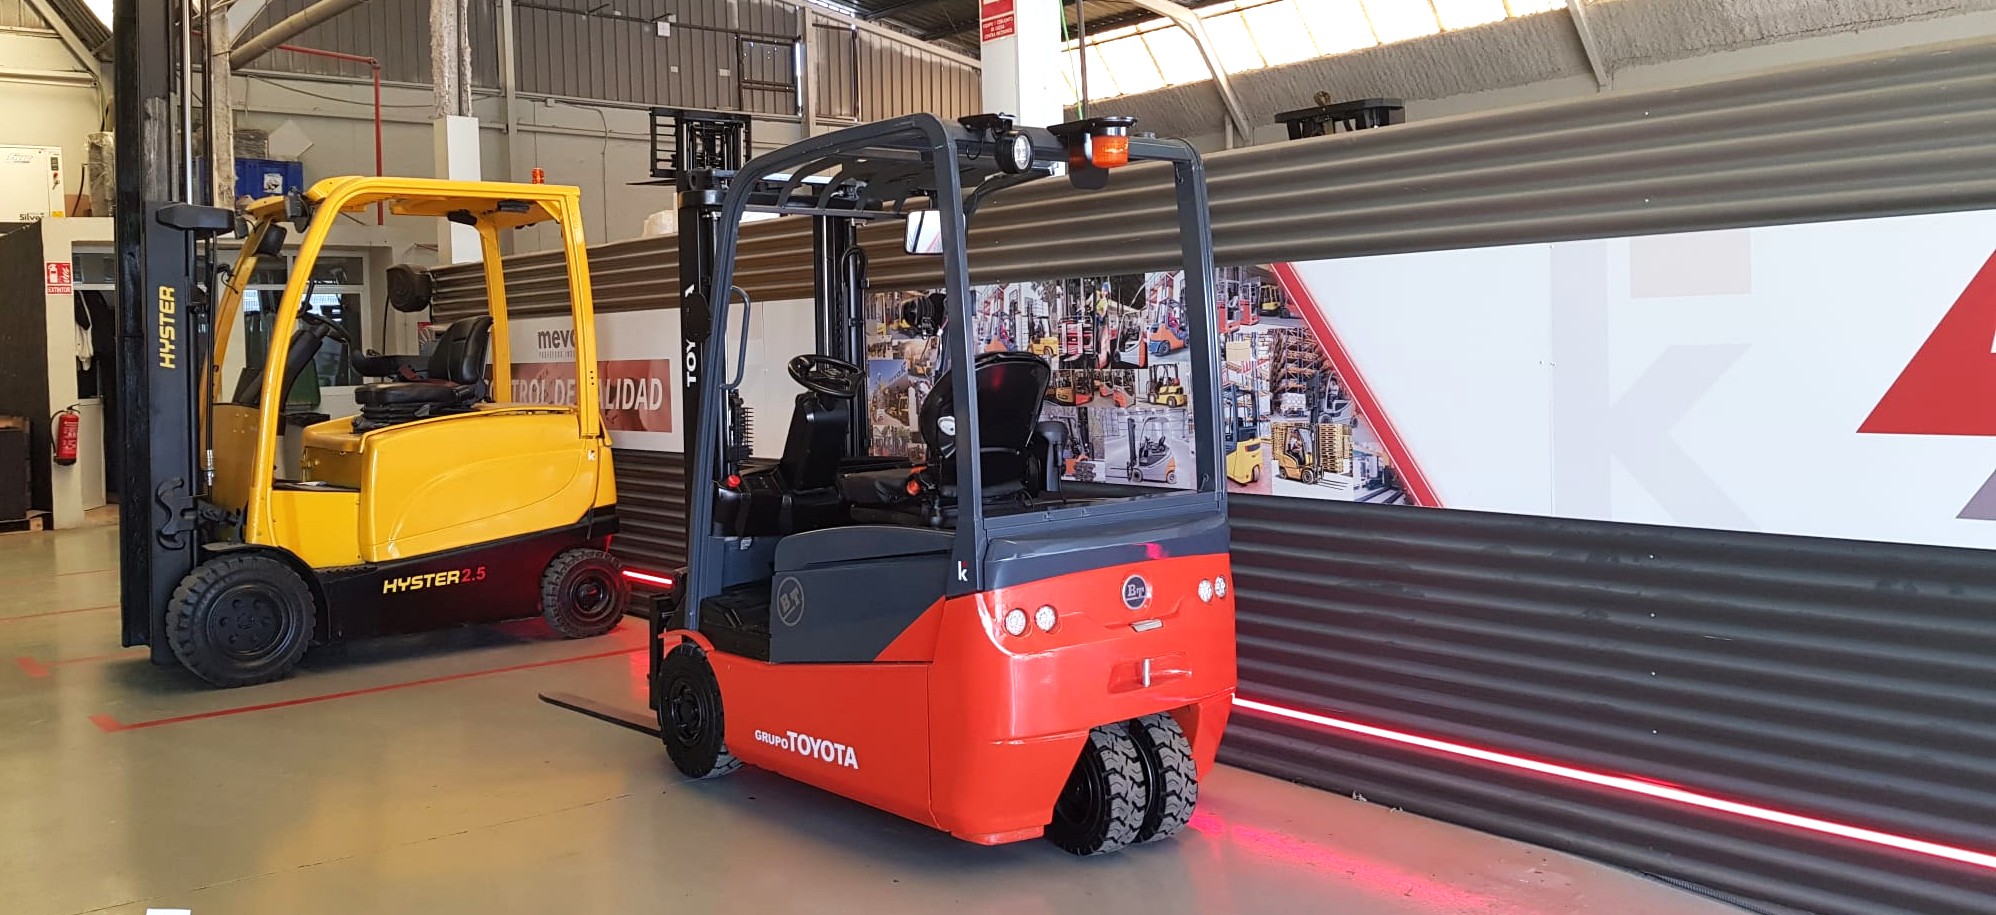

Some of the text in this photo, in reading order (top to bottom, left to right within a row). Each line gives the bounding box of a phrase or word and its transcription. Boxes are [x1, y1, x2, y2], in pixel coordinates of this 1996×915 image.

[159, 285, 176, 369] HYSTER
[598, 377, 664, 411] ALIDAD
[383, 566, 487, 594] HYSTER 2.5
[957, 560, 969, 582] k
[754, 729, 859, 770] GRUPO TOYOTA
